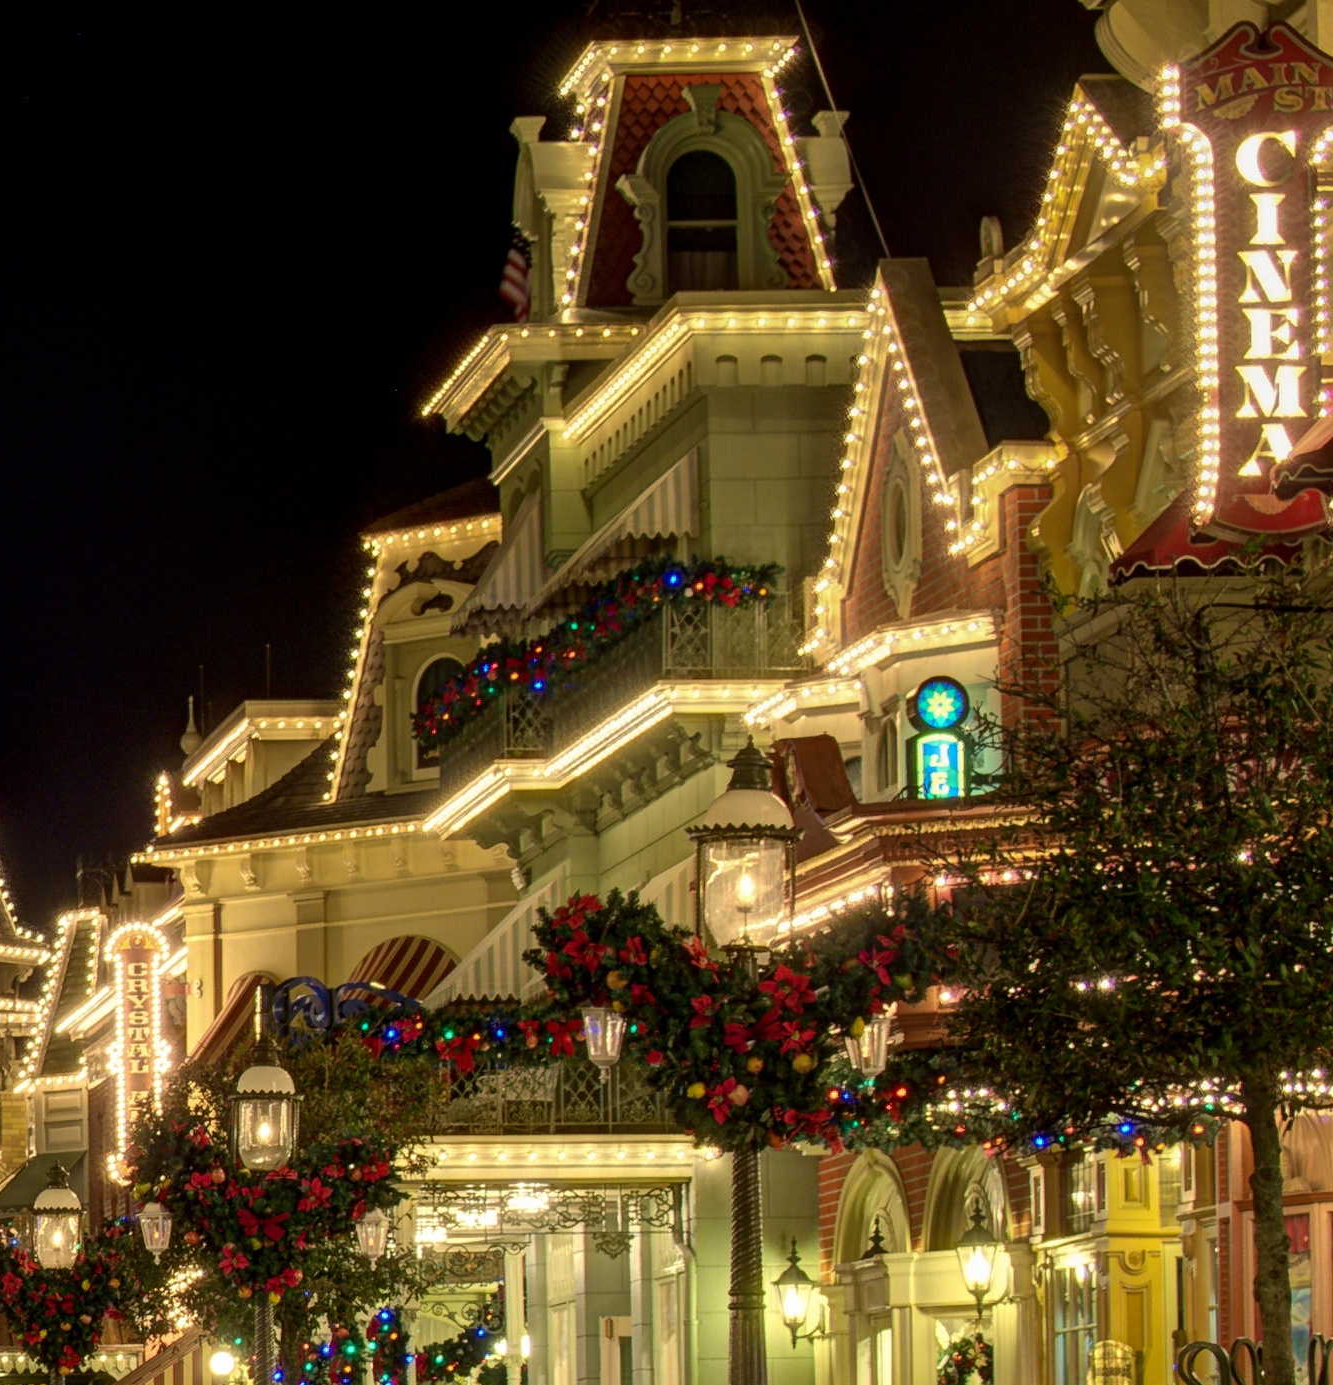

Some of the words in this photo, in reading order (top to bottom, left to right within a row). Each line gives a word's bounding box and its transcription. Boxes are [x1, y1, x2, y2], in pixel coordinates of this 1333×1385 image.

[1195, 62, 1322, 113] MAIN
[1235, 130, 1308, 477] CINEMA
[127, 962, 151, 1074] CRYSTAL
